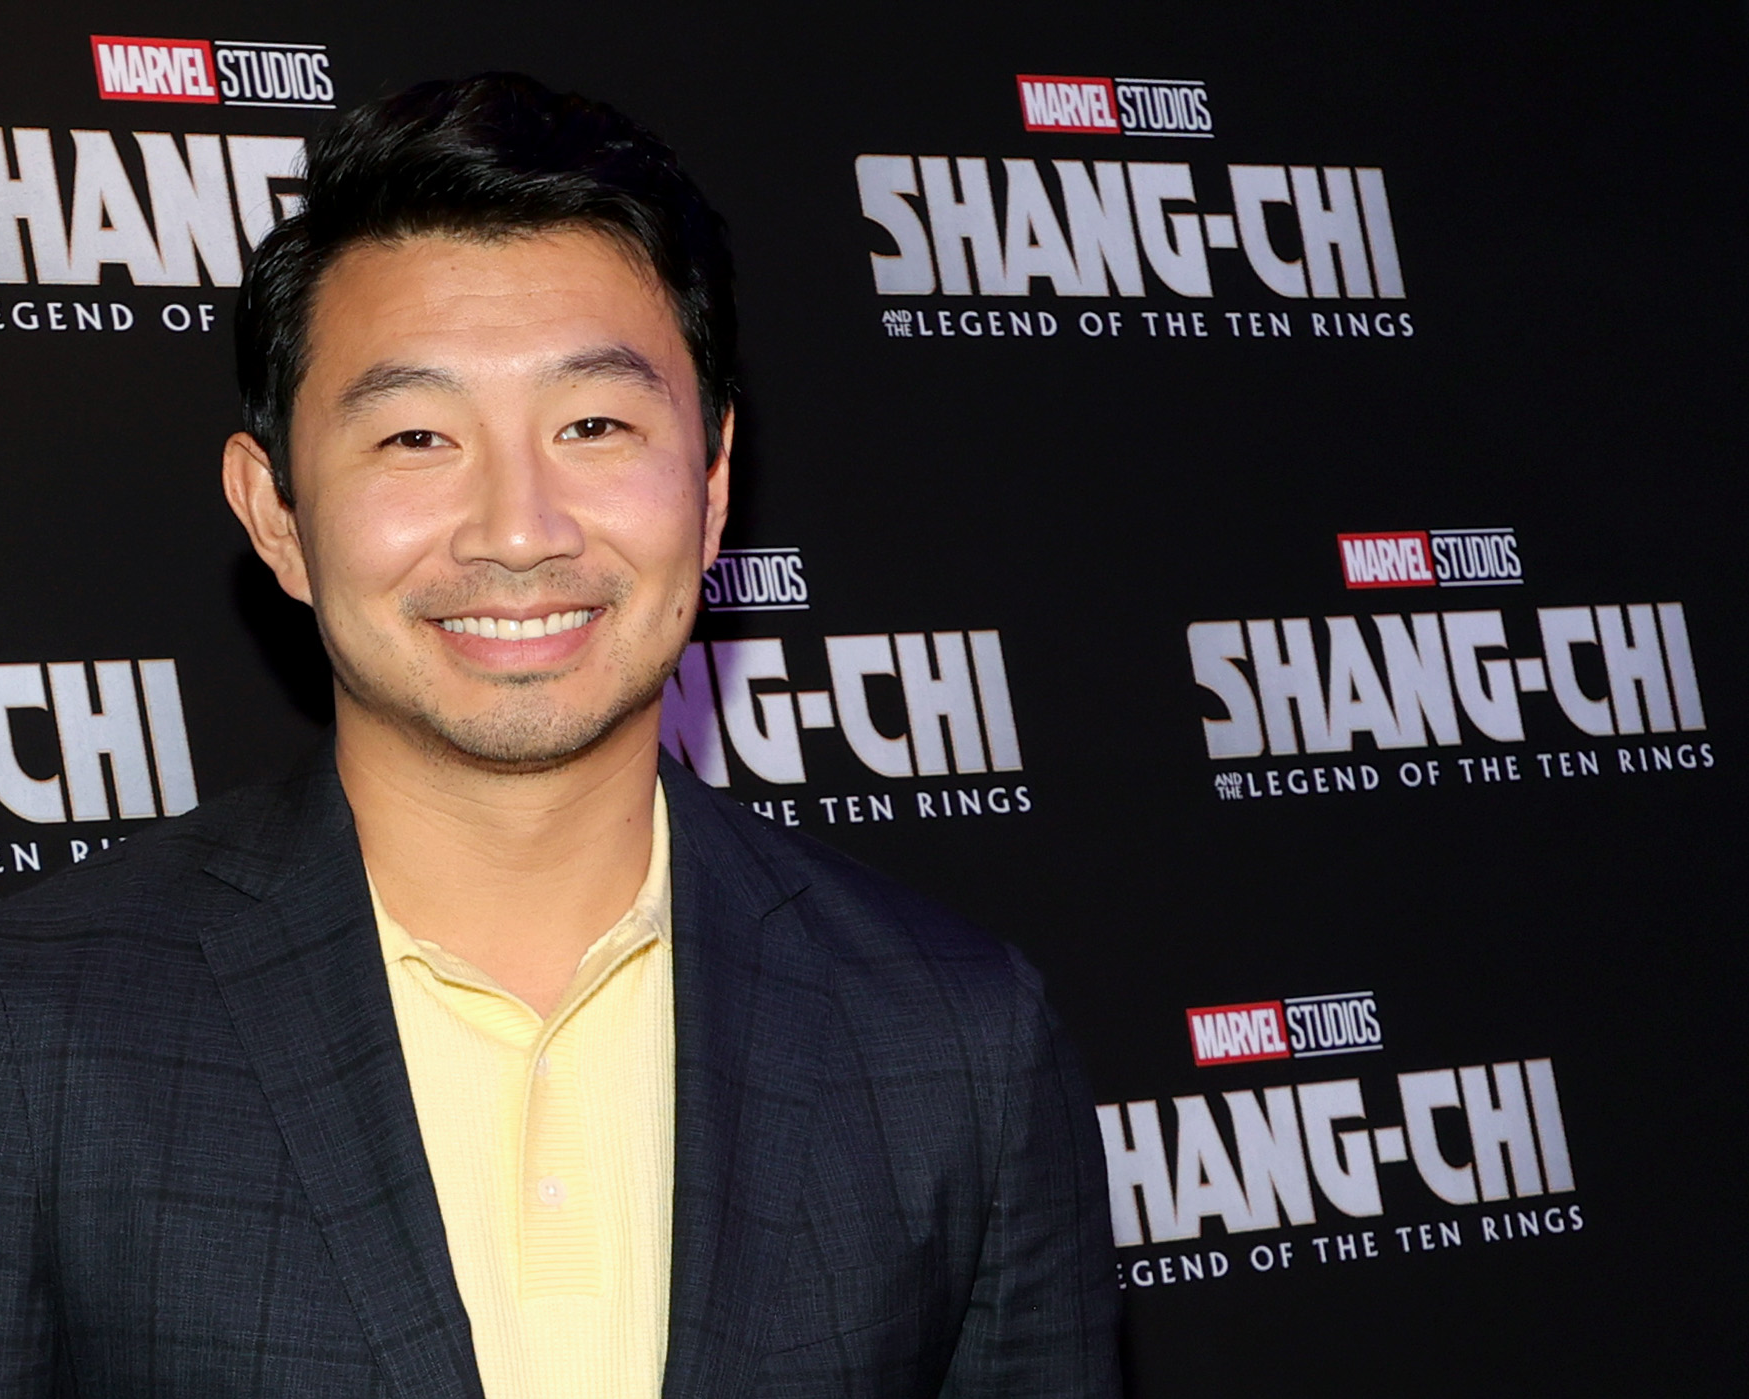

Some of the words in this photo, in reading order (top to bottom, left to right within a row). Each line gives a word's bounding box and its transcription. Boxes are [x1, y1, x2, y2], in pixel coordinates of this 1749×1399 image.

[98, 44, 215, 96] MARVEL
[218, 49, 333, 101] STUDIOS
[1022, 83, 1116, 127] MARVEL
[1118, 86, 1211, 130] STUDIOS
[855, 155, 1405, 298] SHANG-CHI
[162, 304, 214, 331] OF
[883, 310, 912, 323] AND
[885, 324, 912, 336] THE
[917, 311, 1057, 336] LEGEND
[1080, 312, 1121, 336] OF
[1142, 313, 1207, 336] THE
[1226, 313, 1291, 336] TEN
[1312, 313, 1413, 336] RINGS
[703, 556, 807, 602] STUDIOS
[1343, 539, 1432, 582] MARVEL
[1433, 535, 1521, 579] STUDIOS
[1187, 603, 1705, 759] SHANG-CHI
[1215, 772, 1242, 787] AND
[1218, 786, 1243, 800] THE
[1247, 766, 1378, 796] LEGEND
[1400, 761, 1439, 786] OF
[1459, 756, 1520, 782] THE
[1537, 751, 1598, 777] TEN
[1619, 744, 1713, 772] RINGS
[820, 795, 893, 823] TEN
[917, 786, 1030, 817] RINGS
[1192, 1009, 1286, 1059] MARVEL
[1287, 999, 1381, 1050] STUDIOS
[1251, 1243, 1292, 1270] OF
[1313, 1232, 1378, 1262] THE
[1396, 1221, 1460, 1252] TEN
[1482, 1206, 1583, 1241] RINGS
